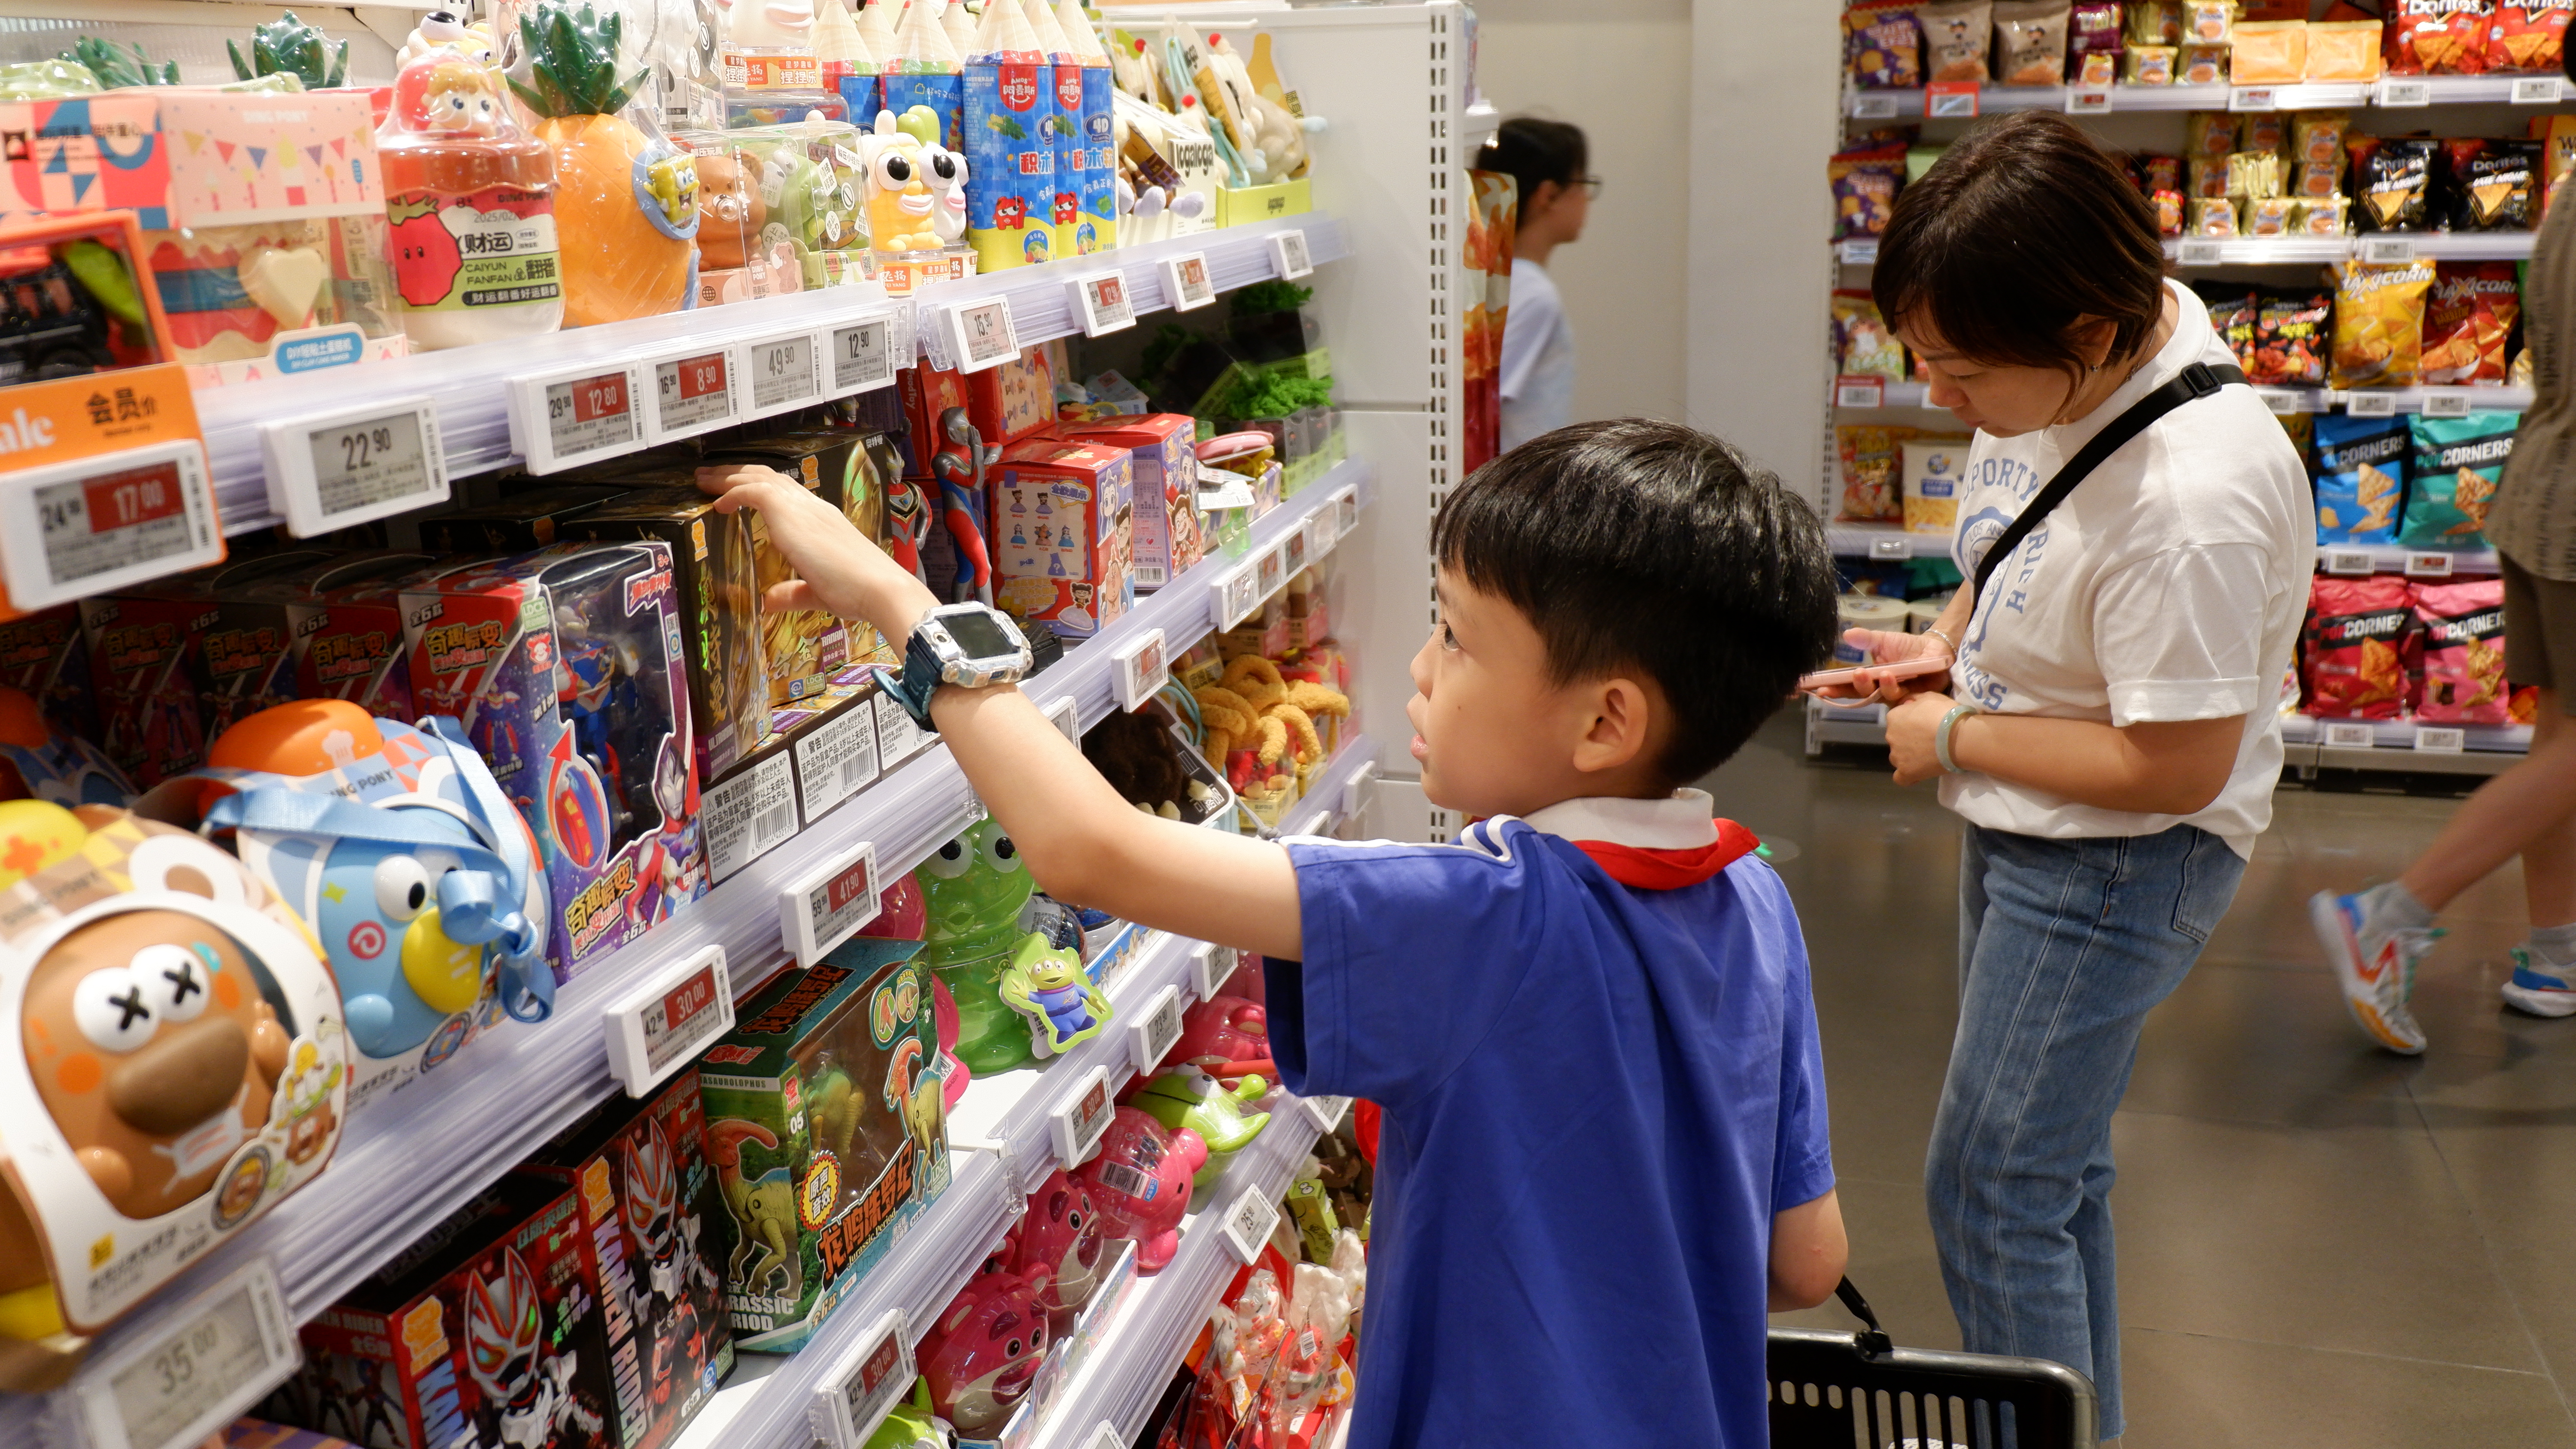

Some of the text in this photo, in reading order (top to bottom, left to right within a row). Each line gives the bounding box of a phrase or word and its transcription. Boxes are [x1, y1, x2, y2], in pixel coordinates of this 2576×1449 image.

[786, 61, 812, 69] 星梦趣味
[780, 70, 817, 85] 捏捏乐
[1003, 85, 1035, 96] 阿麦斯
[1093, 118, 1109, 133] 4D
[691, 146, 723, 157] 解压玩具
[1176, 142, 1215, 179] logaloga
[734, 145, 744, 179] DING
[2372, 157, 2426, 173] Doritos
[2472, 156, 2528, 173] Doritos
[465, 262, 507, 273] CAIYUN
[752, 265, 763, 273] DING
[752, 272, 766, 280] PONY
[467, 274, 513, 285] FANFAN
[974, 312, 993, 337] 15.90
[848, 330, 869, 359] 12.90
[769, 346, 794, 377] 49.90
[698, 365, 717, 392] 8.90
[86, 386, 158, 426] 会员价
[588, 385, 618, 415] 12.80
[866, 434, 883, 449] 奥特曼
[1051, 484, 1089, 500] 全款展示
[657, 554, 669, 567] 3+
[2006, 528, 2048, 614] RICH
[821, 628, 844, 647] RAMAN
[827, 641, 844, 652] FIGURE
[806, 674, 823, 685] LDCX
[808, 737, 822, 755] 警告
[358, 768, 394, 790] PONY
[839, 769, 875, 797] 6 951144 422170
[714, 789, 731, 809] 警告
[756, 837, 775, 851] 951144
[775, 825, 793, 839] 422170
[839, 871, 860, 902] 41.90
[676, 981, 705, 1020] 30.00
[924, 1007, 932, 1023] 3+
[790, 1110, 804, 1134] 05
[809, 1166, 829, 1202] 原声
[811, 1185, 831, 1221] 音效
[847, 1207, 897, 1269] Jurassic Period
[731, 1295, 795, 1315] RASSIC
[731, 1313, 773, 1331] RIOD
[611, 1337, 647, 1449] RIDER
